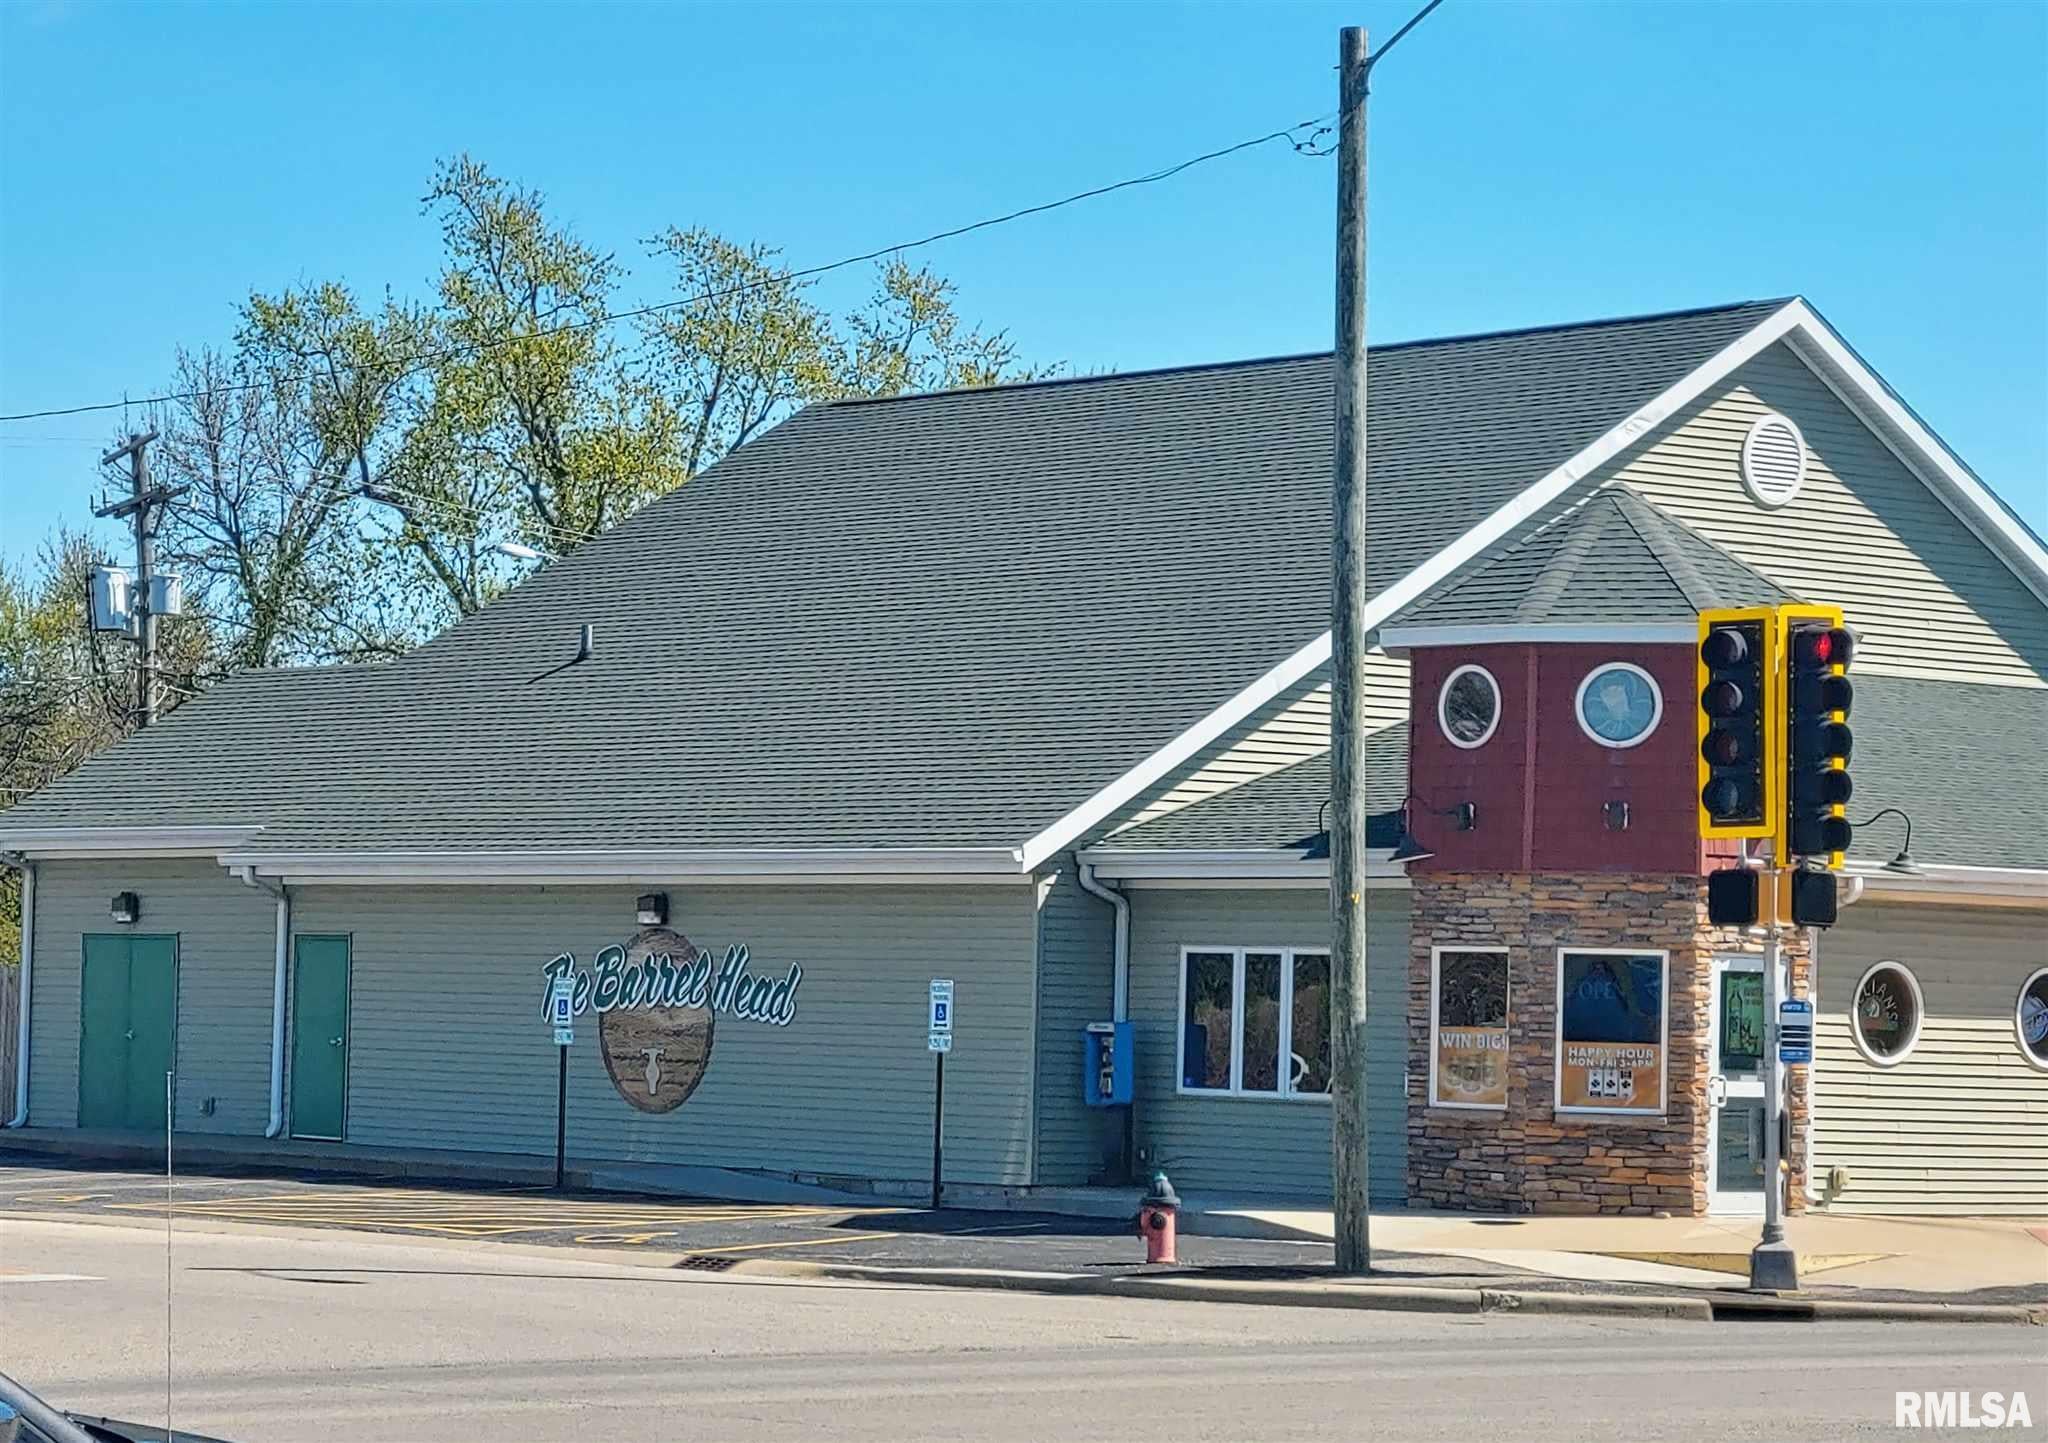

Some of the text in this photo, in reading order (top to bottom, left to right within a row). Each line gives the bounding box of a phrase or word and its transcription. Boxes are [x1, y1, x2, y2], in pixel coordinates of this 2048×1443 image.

[541, 943, 802, 1027] Te Barrel Head
[1439, 1032, 1472, 1049] WIN
[1568, 1047, 1654, 1059] HAPPY HOUR
